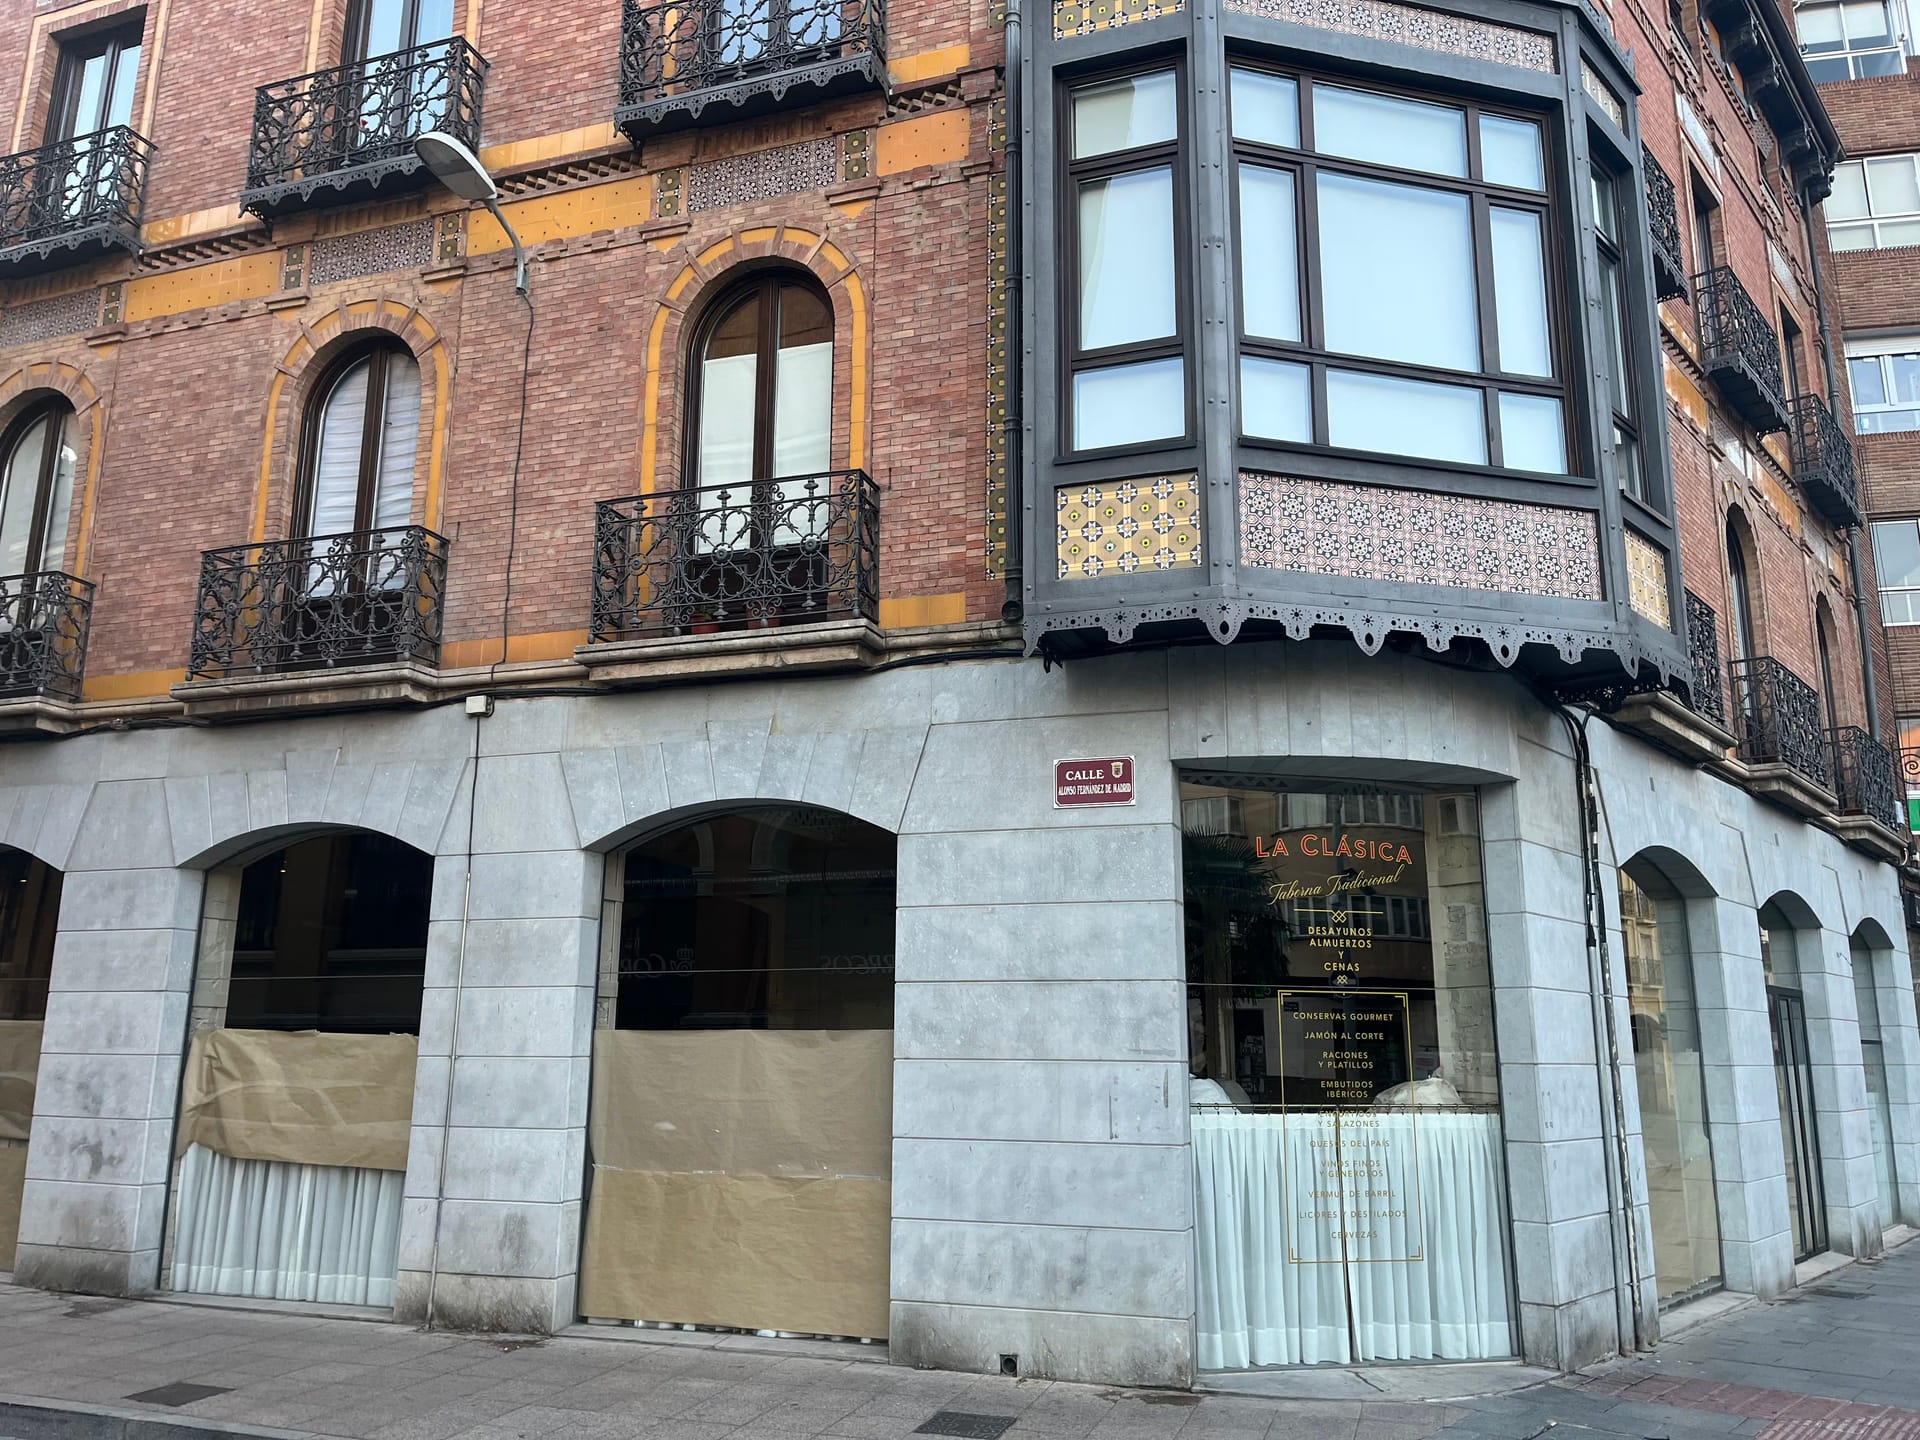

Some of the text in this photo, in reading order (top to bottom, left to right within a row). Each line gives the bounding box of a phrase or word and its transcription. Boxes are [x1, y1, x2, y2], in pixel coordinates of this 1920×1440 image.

[1065, 769, 1105, 781] CALLE
[1058, 785, 1077, 796] ALONSO
[1105, 784, 1112, 794] DE
[1112, 783, 1132, 793] MADRID
[1255, 833, 1413, 865] LA CLÁSICA
[1266, 863, 1406, 906] Taberna Tradicional
[1308, 926, 1372, 936] DESAYUNOS
[1309, 938, 1372, 948] ALMUERZOS
[1338, 950, 1344, 959] Y
[1323, 962, 1360, 971] CENAS
[1293, 1012, 1394, 1021] CONSERVAS GOURMET
[1304, 1030, 1384, 1040] JAMÓN AL CORTE
[1322, 1051, 1368, 1059] RACIONES
[1318, 1061, 1374, 1069] Y PLATILLOS
[1326, 1089, 1368, 1098] IBÉRICOS
[1318, 1120, 1380, 1128] Y SALAZONES
[1310, 1140, 1347, 1148] QUESS
[1350, 1140, 1367, 1148] DEL
[1353, 1159, 1381, 1167] FINOS
[1319, 1170, 1325, 1178] Y
[1349, 1190, 1361, 1198] DE
[1299, 1211, 1338, 1219] LICORES
[1350, 1210, 1407, 1218] DESILADOS
